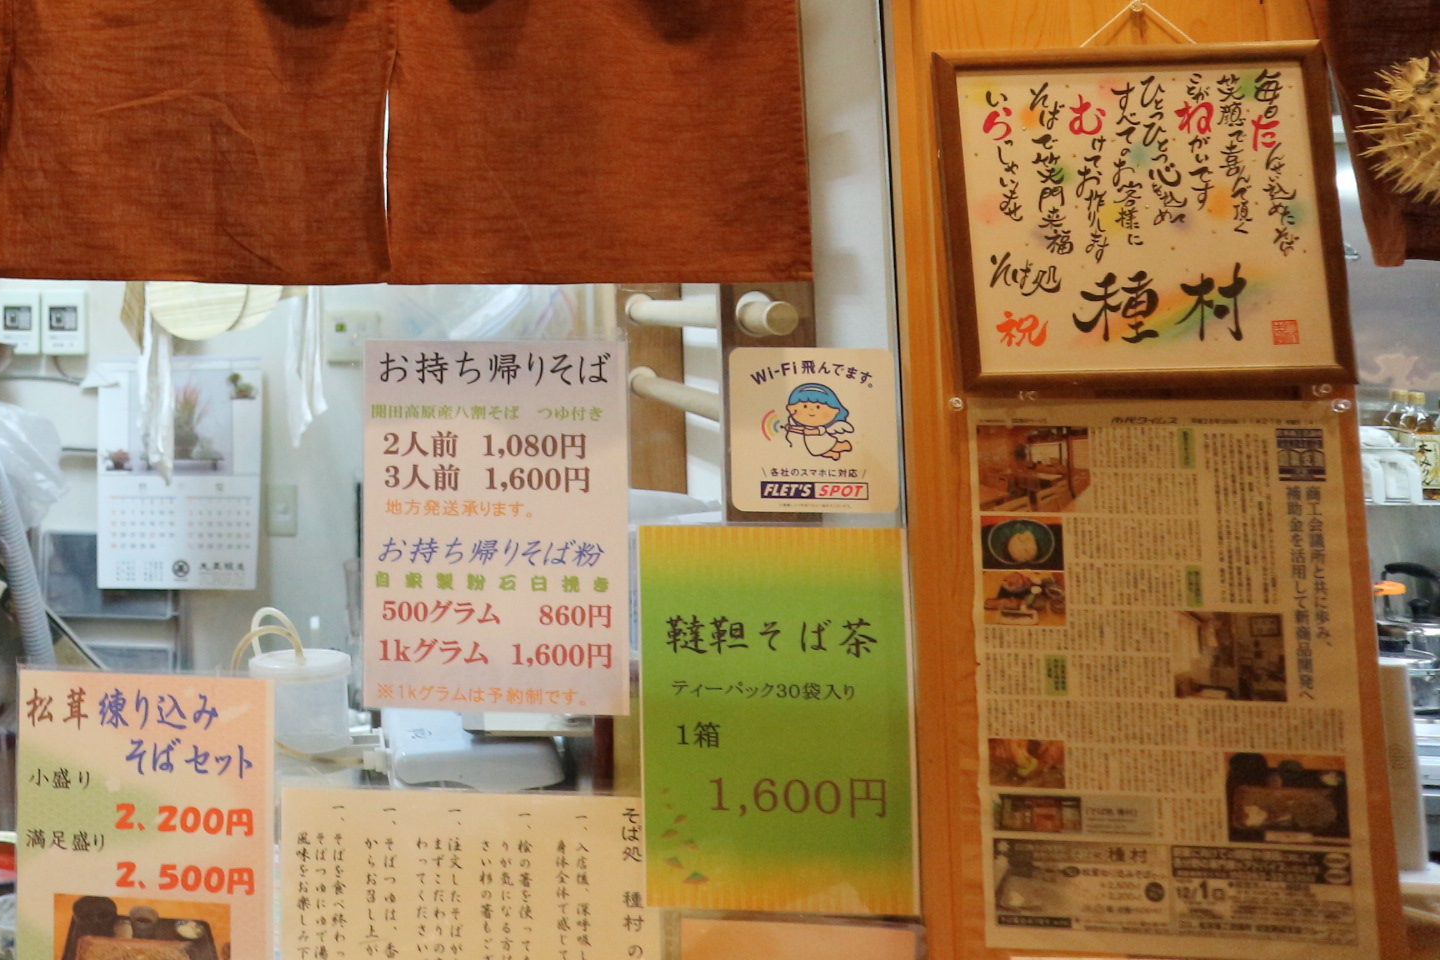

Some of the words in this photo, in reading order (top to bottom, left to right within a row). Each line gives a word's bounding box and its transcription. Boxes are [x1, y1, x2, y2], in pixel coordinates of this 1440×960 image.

[990, 252, 1062, 297] そば処
[996, 311, 1049, 348] 祝
[379, 351, 611, 387] お持ち帰りそば
[750, 361, 797, 386] Wi-Fi
[801, 360, 874, 389] 飛んでます。
[371, 403, 520, 420] 開田高原産八割そば
[537, 406, 604, 422] つゆ付き
[383, 431, 459, 458] 2人前
[483, 433, 587, 460] 1,080円
[384, 464, 461, 491] 3人前
[485, 466, 591, 493] 1,600円
[770, 468, 858, 478] 各社のスマホに対応
[763, 483, 812, 498] FLET'S
[819, 484, 864, 497] SPOT
[385, 499, 533, 519] 地方発送承ります。
[378, 537, 605, 567] お持ち帰りそば粉
[382, 600, 501, 625] 500グラム
[539, 604, 613, 629] 860円
[666, 615, 878, 658] 韃靼そば茶
[379, 638, 489, 665] 1kグラム
[512, 642, 613, 669] 1,600円
[672, 681, 856, 701] ティーパック30袋入り
[677, 722, 720, 749] 1箱
[125, 738, 253, 779] そばセット
[29, 767, 91, 790] 小盛り
[710, 777, 888, 819] 1,600円
[26, 829, 105, 852] 満足盛り
[622, 808, 643, 862] そば処
[623, 891, 645, 959] 種村の
